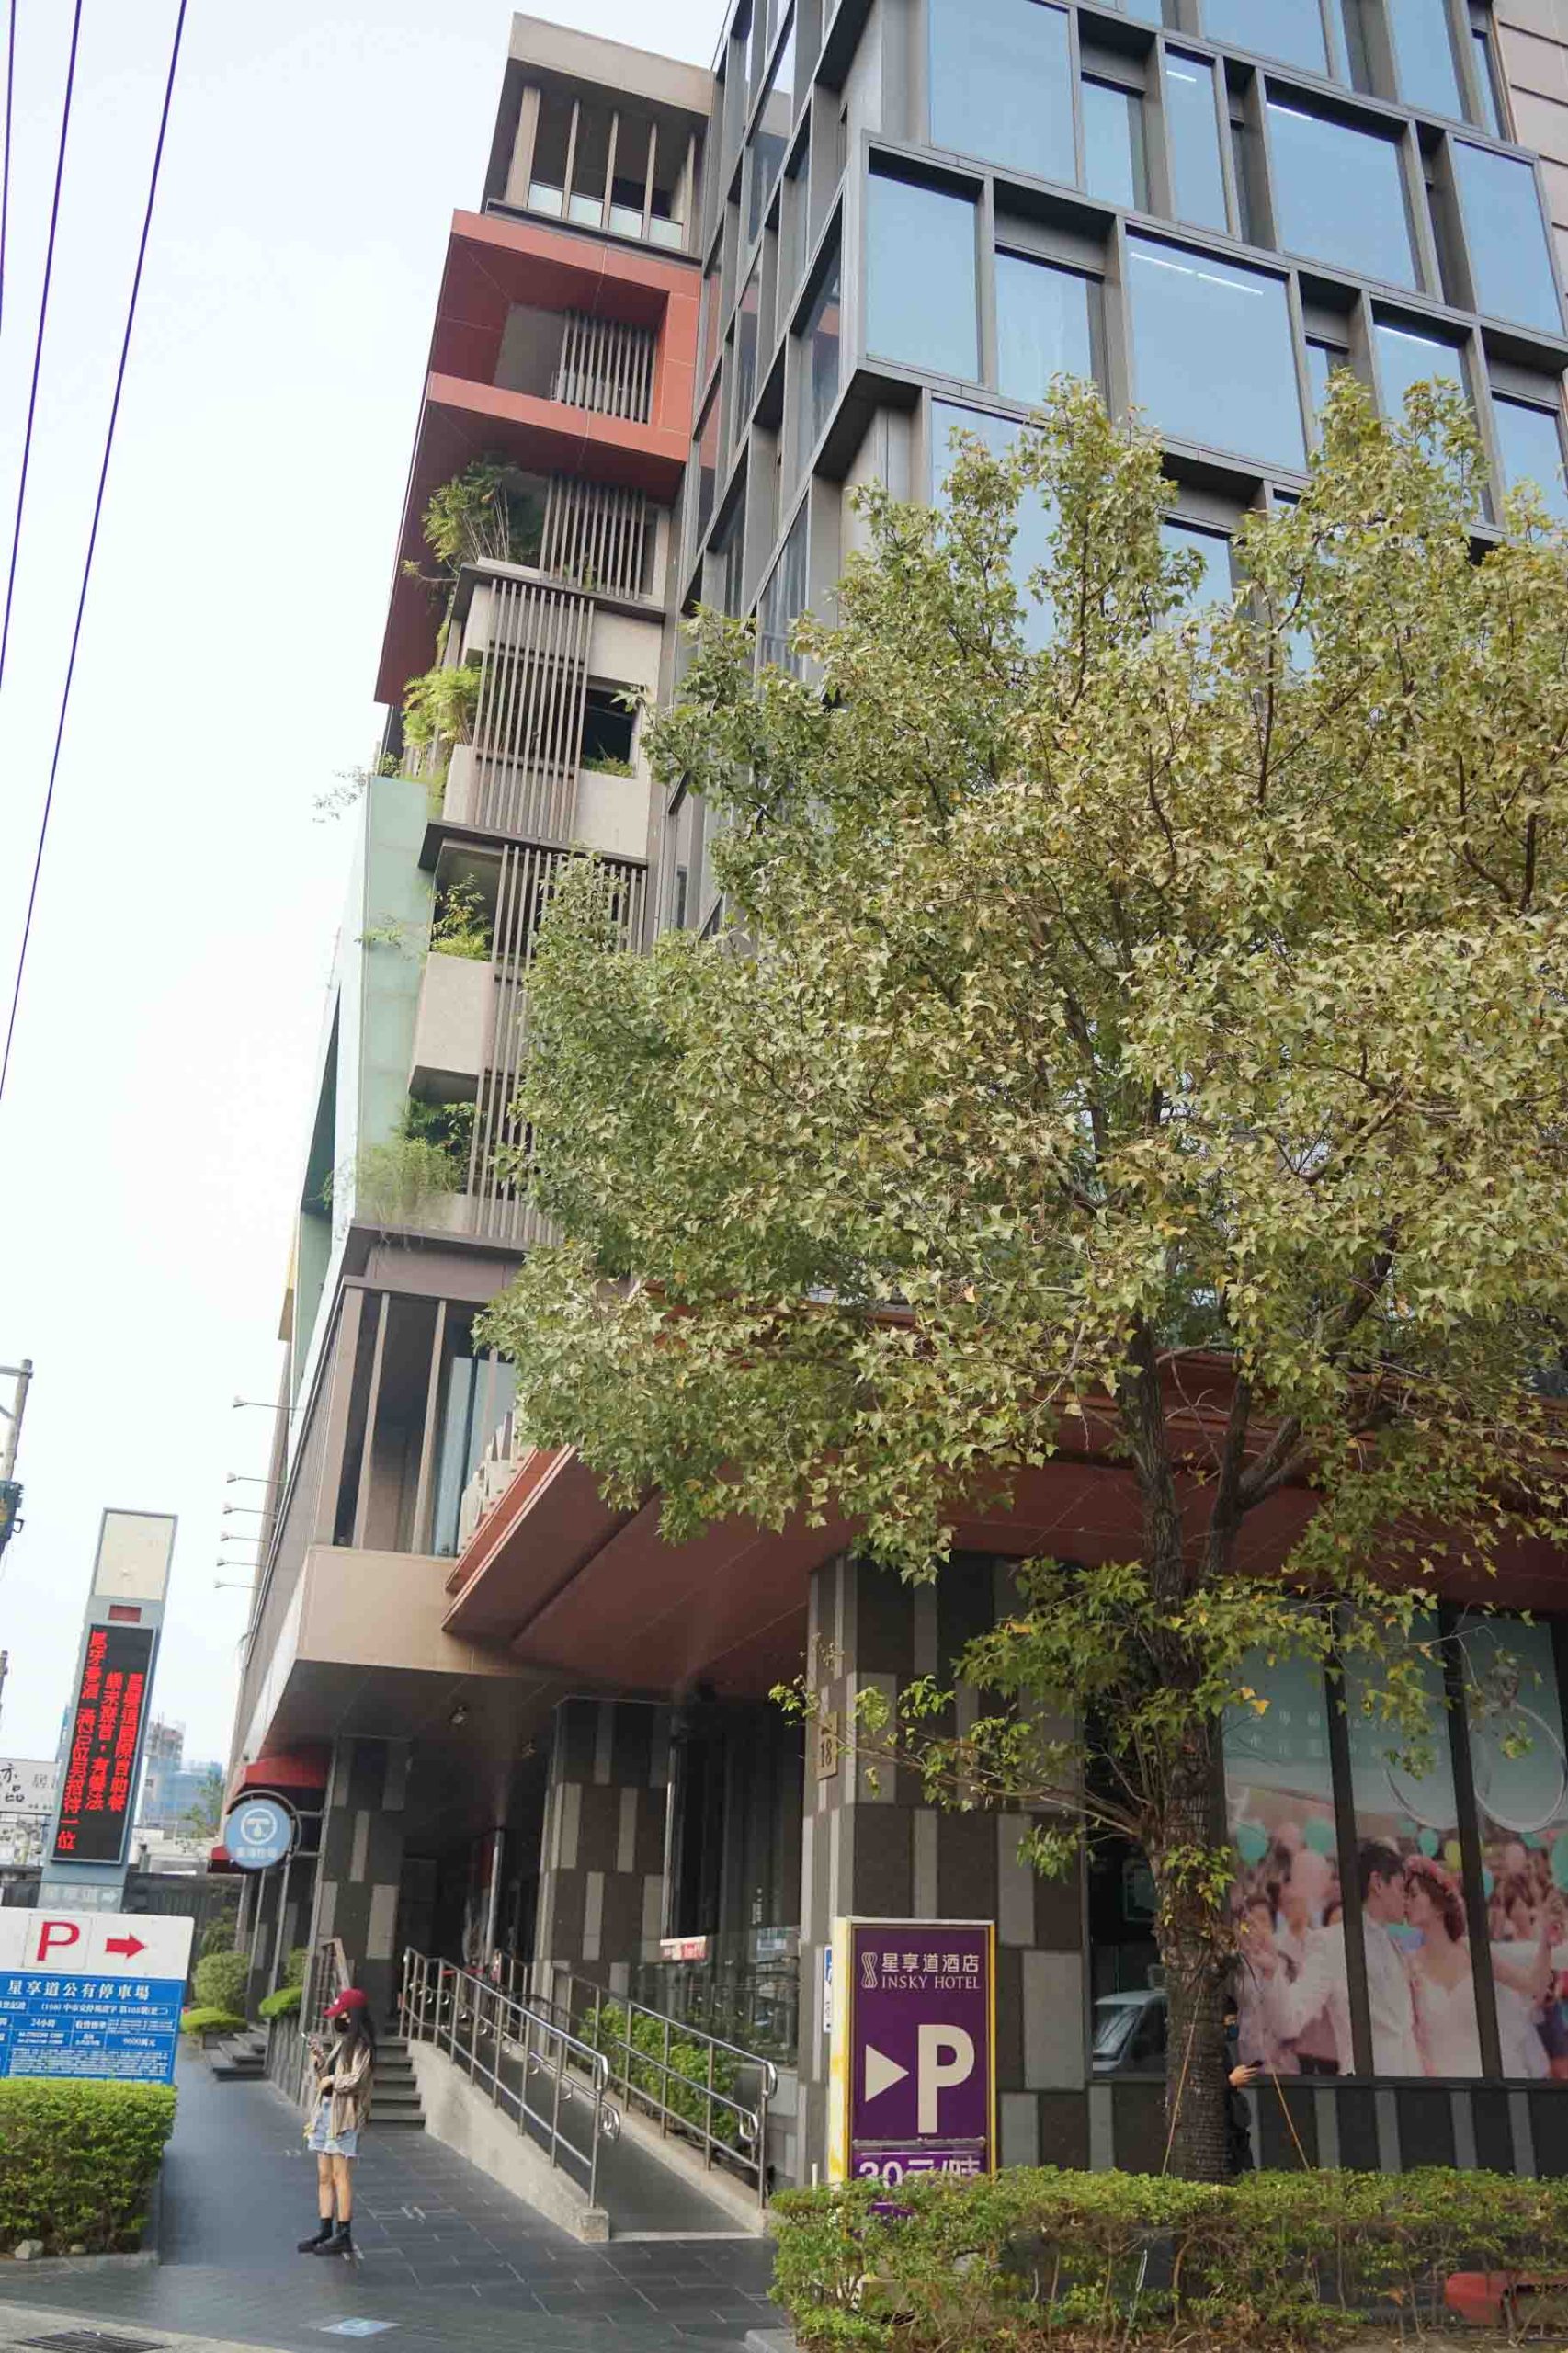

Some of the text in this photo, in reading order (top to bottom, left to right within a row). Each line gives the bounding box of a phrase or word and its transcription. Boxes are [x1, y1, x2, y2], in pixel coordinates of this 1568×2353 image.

[36, 1921, 81, 1961] P
[881, 1952, 980, 1973] 星享道酒店
[7, 1979, 151, 2001] 星享道公有停車場
[881, 1975, 981, 1990] INSKY HOTEL
[918, 2024, 975, 2133] P
